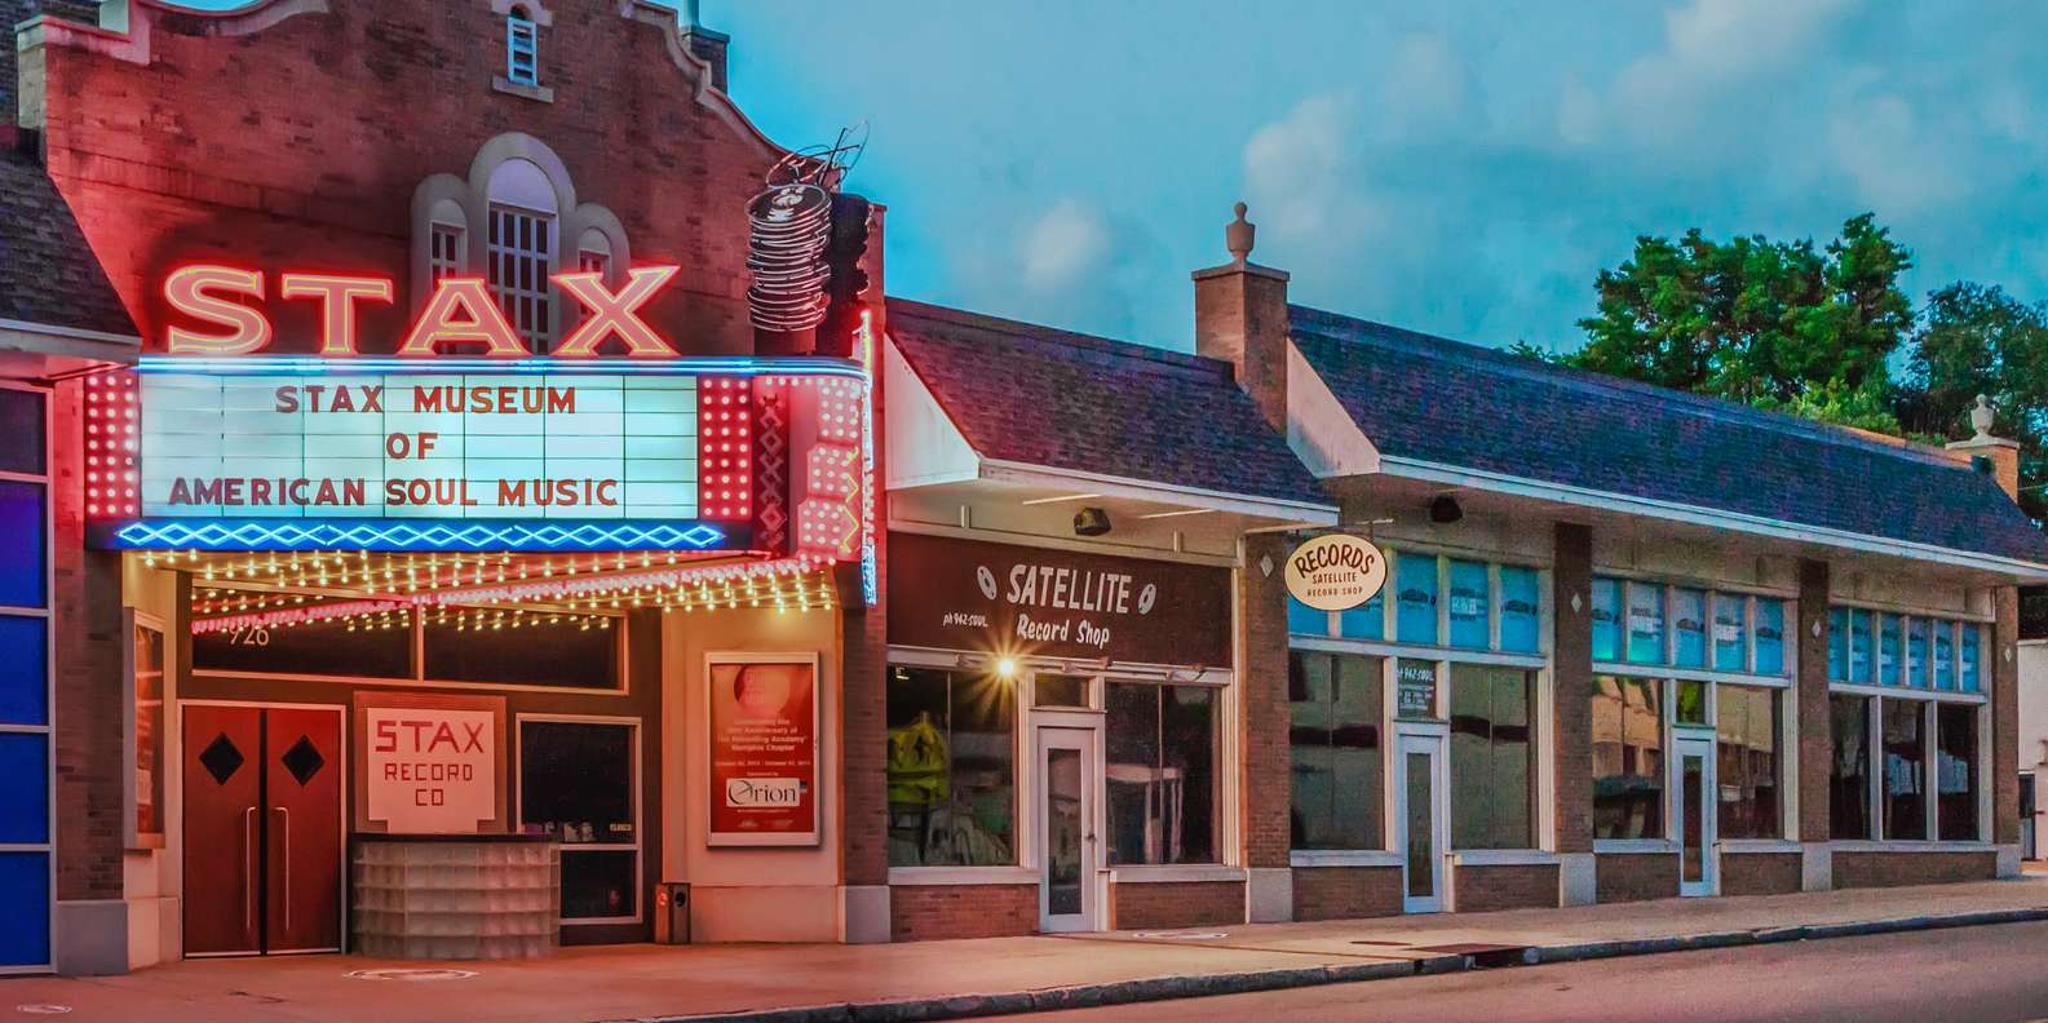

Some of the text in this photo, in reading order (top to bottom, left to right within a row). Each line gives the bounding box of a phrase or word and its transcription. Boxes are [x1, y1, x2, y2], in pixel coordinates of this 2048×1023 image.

[165, 264, 681, 357] STAX
[275, 385, 576, 414] STAX MUSEUM
[386, 432, 439, 460] OF
[168, 477, 619, 507] AMERICAN SOUL MUSIC
[1294, 543, 1375, 579] RECORDS
[1006, 563, 1133, 615] SATELLITE
[1307, 586, 1362, 597] RECORD SHOP
[1312, 571, 1358, 585] SATELLITE
[1016, 613, 1110, 649] Record Shop
[375, 719, 485, 754] STAX
[384, 763, 473, 781] RECORD
[415, 788, 444, 807] CO
[728, 779, 796, 805] Orion
